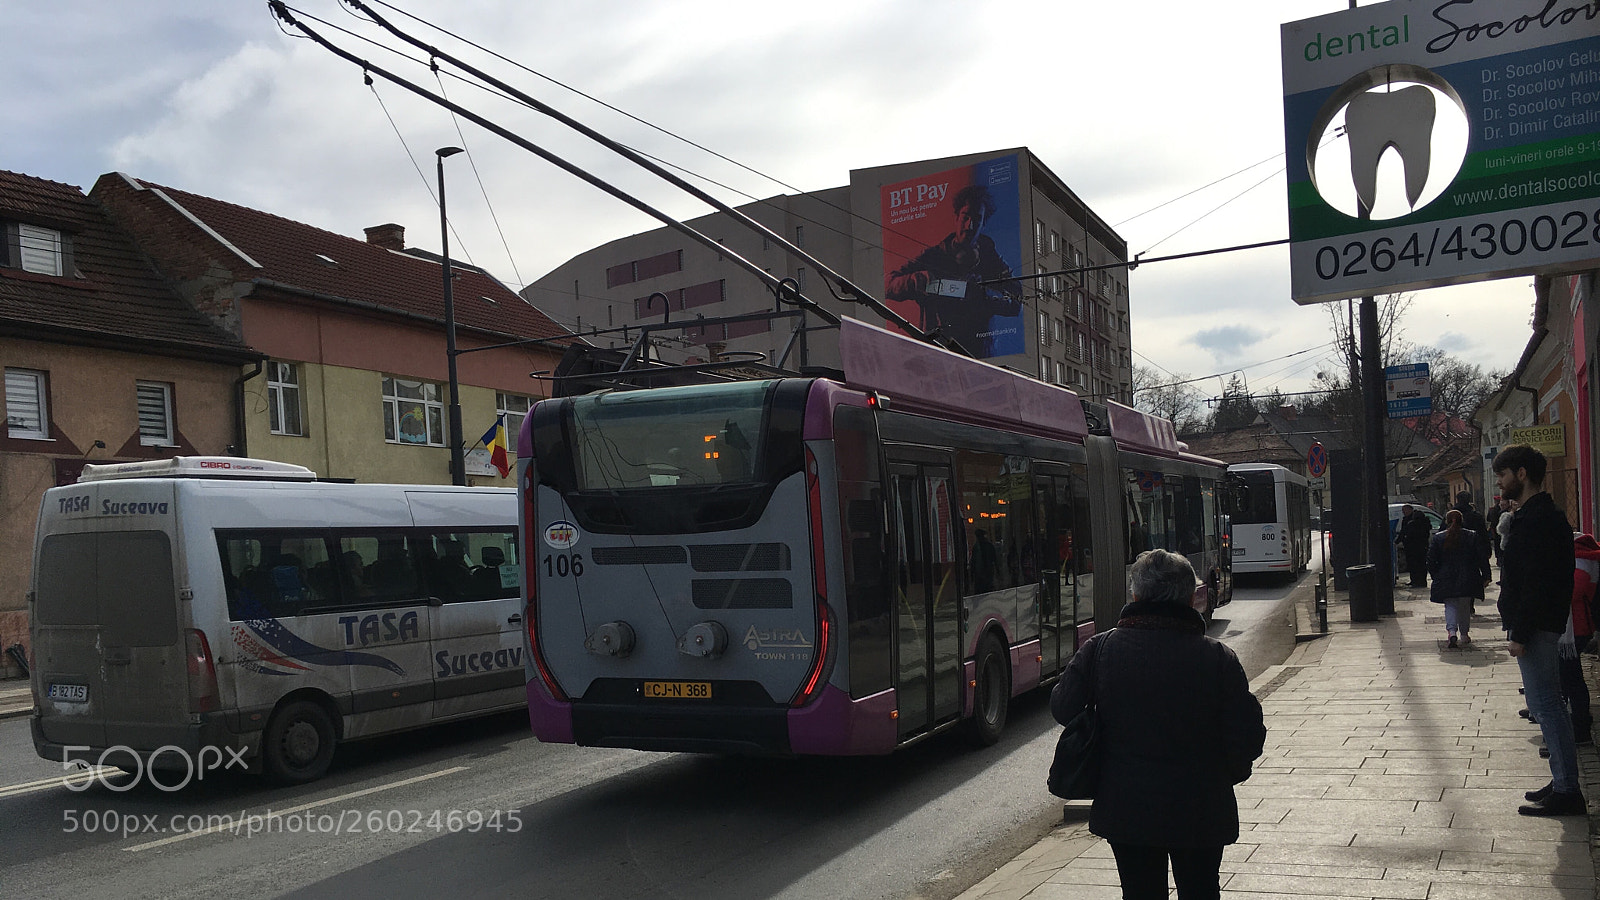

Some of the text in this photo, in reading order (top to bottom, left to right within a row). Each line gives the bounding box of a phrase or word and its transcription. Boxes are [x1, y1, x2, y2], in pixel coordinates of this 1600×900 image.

[1304, 15, 1410, 62] dental
[1481, 69, 1501, 84] Dr.
[1506, 58, 1564, 79] Socolov
[1482, 88, 1502, 102] Dr.
[1507, 77, 1565, 98] Socolov
[1483, 107, 1503, 122] Dr.
[1508, 97, 1566, 117] Socolov
[1484, 126, 1504, 141] Dr.
[1509, 118, 1549, 137] Dimir
[1485, 150, 1541, 169] luni-vineri
[1545, 145, 1574, 159] orele
[890, 182, 949, 208] BT Pay
[1513, 427, 1562, 438] ACCESORII
[1513, 434, 1562, 444] SERVICE GSM
[59, 495, 169, 515] TASA Suceava
[1261, 533, 1275, 541] 800
[543, 553, 584, 577] 106
[338, 610, 419, 647] TASA
[435, 647, 524, 678] Suceav
[754, 652, 786, 660] TOWN
[52, 685, 57, 697] B
[69, 686, 84, 698] TAS
[652, 683, 708, 697] CJ-N 368
